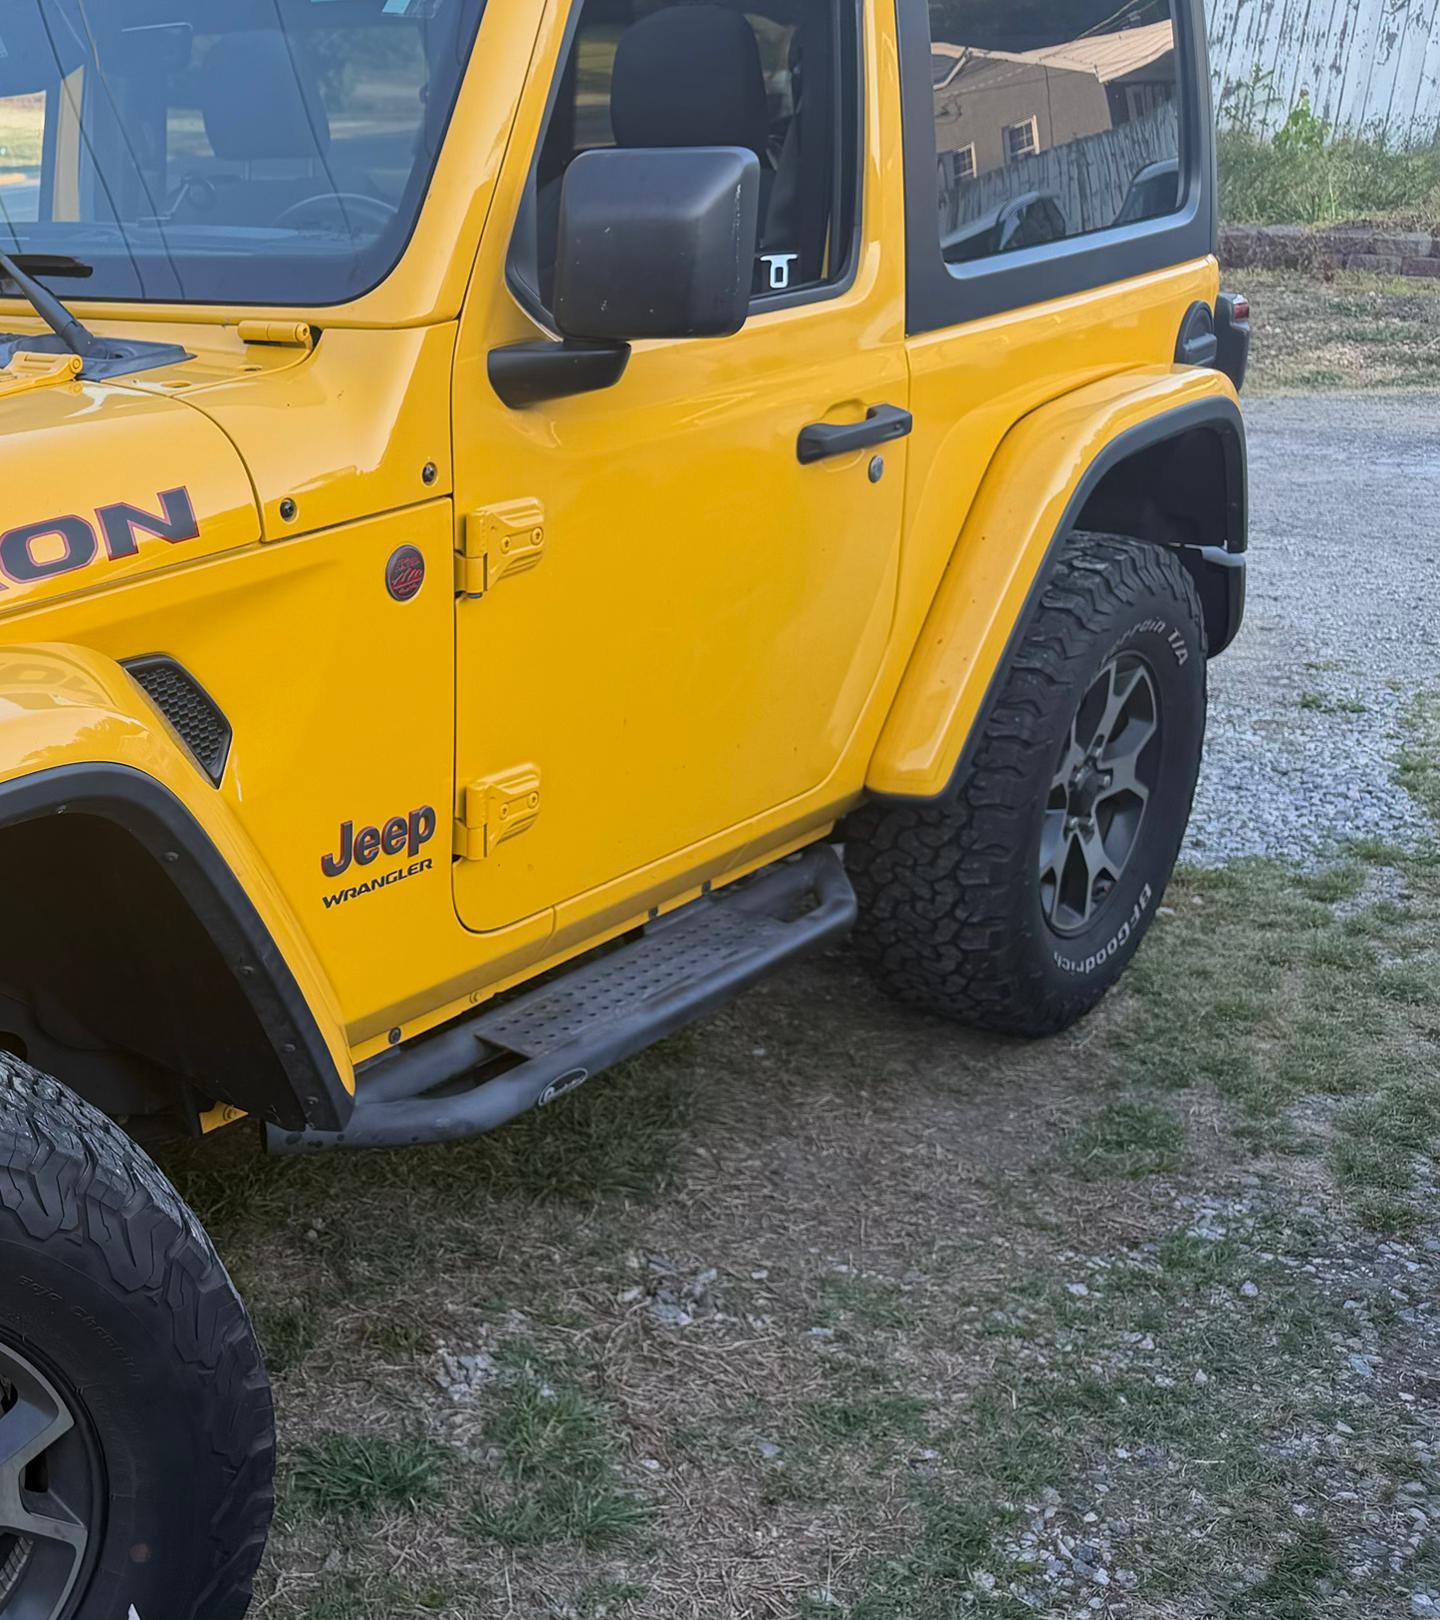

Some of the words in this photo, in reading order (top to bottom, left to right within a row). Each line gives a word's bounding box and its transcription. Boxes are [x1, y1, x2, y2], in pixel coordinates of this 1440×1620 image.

[1168, 626, 1189, 666] T/A
[321, 805, 436, 877] Jeep
[322, 858, 433, 908] WRANGLER
[1054, 883, 1152, 976] BFGoodrich
